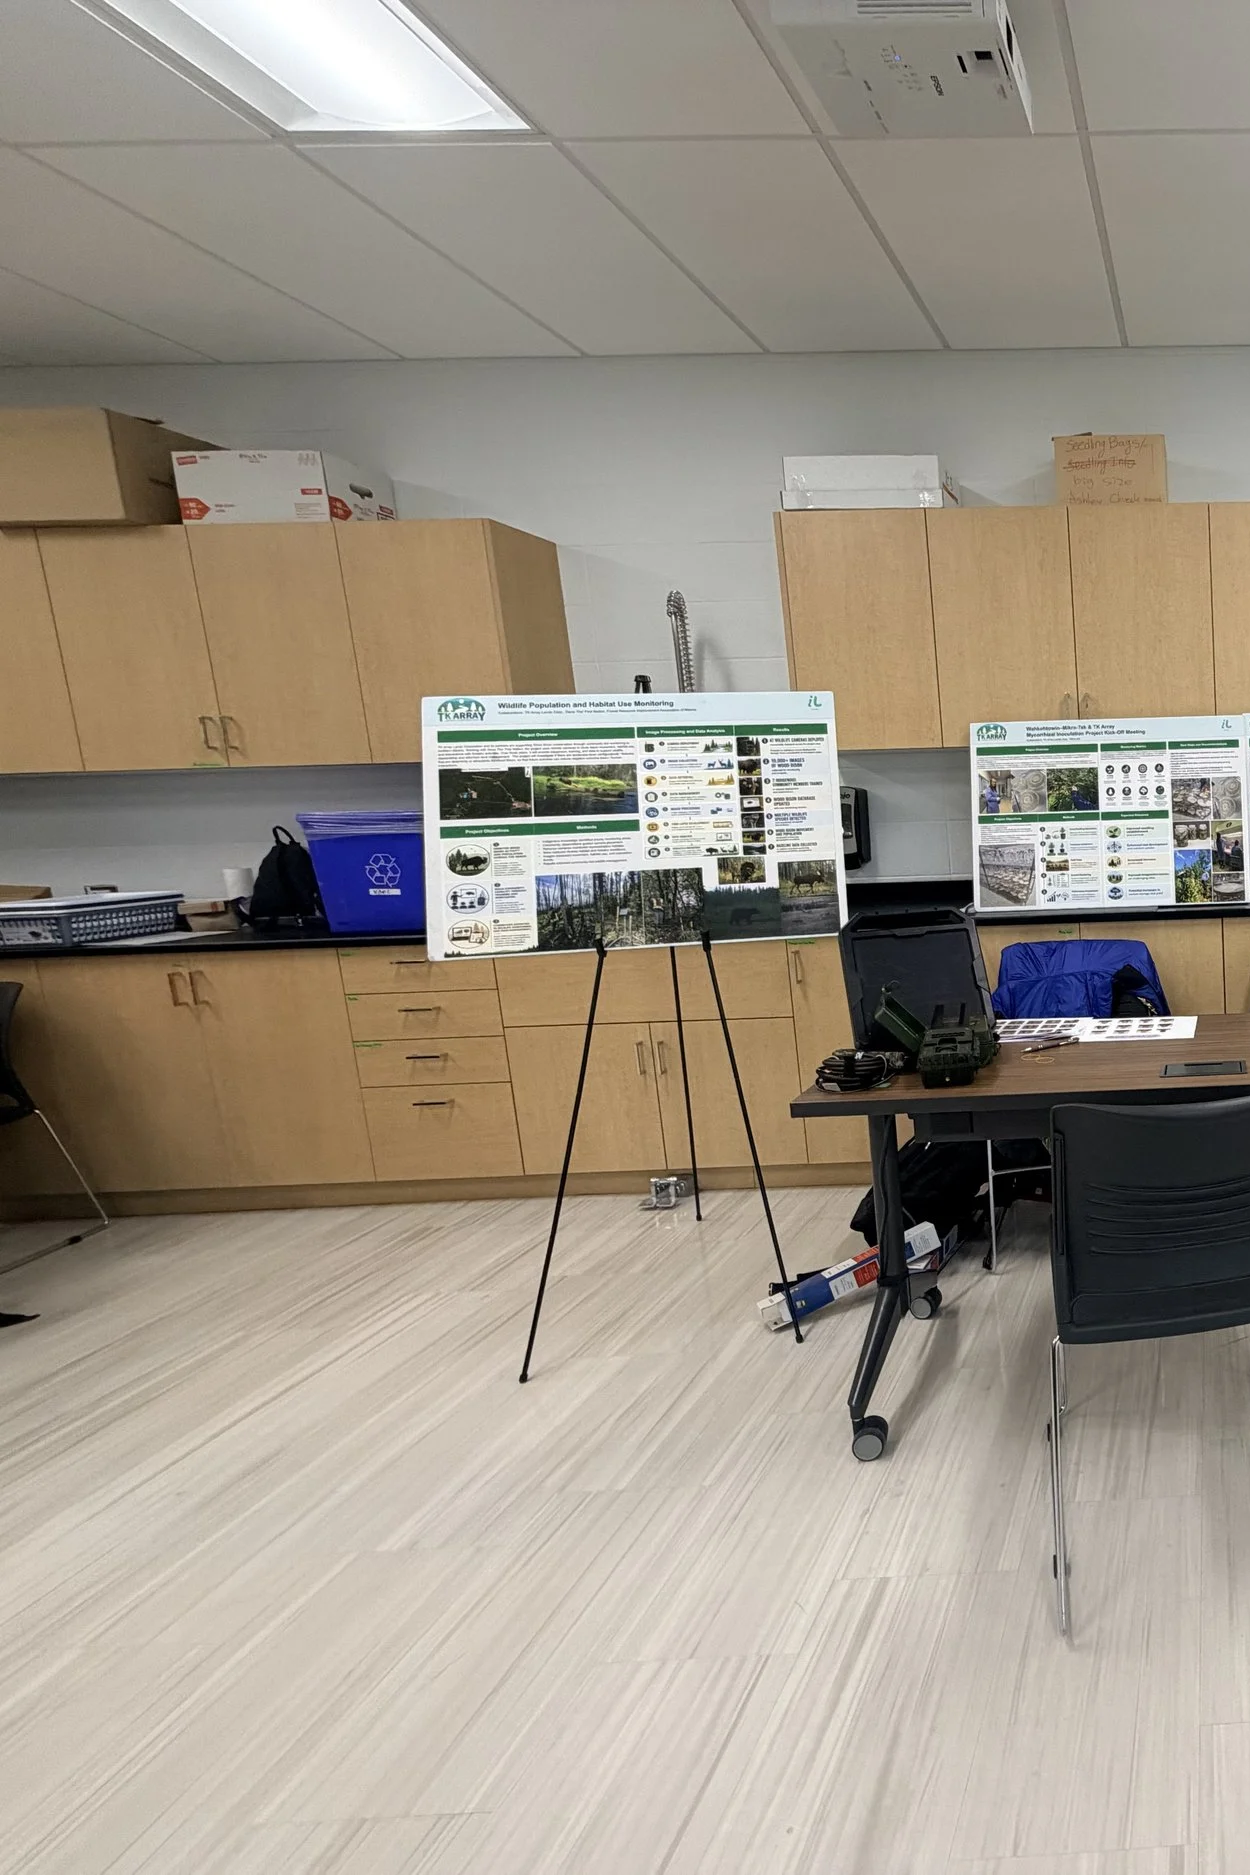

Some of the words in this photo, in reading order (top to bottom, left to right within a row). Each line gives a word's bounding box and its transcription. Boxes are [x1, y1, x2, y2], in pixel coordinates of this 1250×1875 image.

[529, 701, 571, 711] Population
[573, 700, 588, 708] and
[589, 699, 616, 708] Habitat
[618, 699, 633, 707] Use
[634, 699, 674, 708] Monitoring
[438, 712, 452, 722] TK
[453, 712, 487, 721] ARRAY
